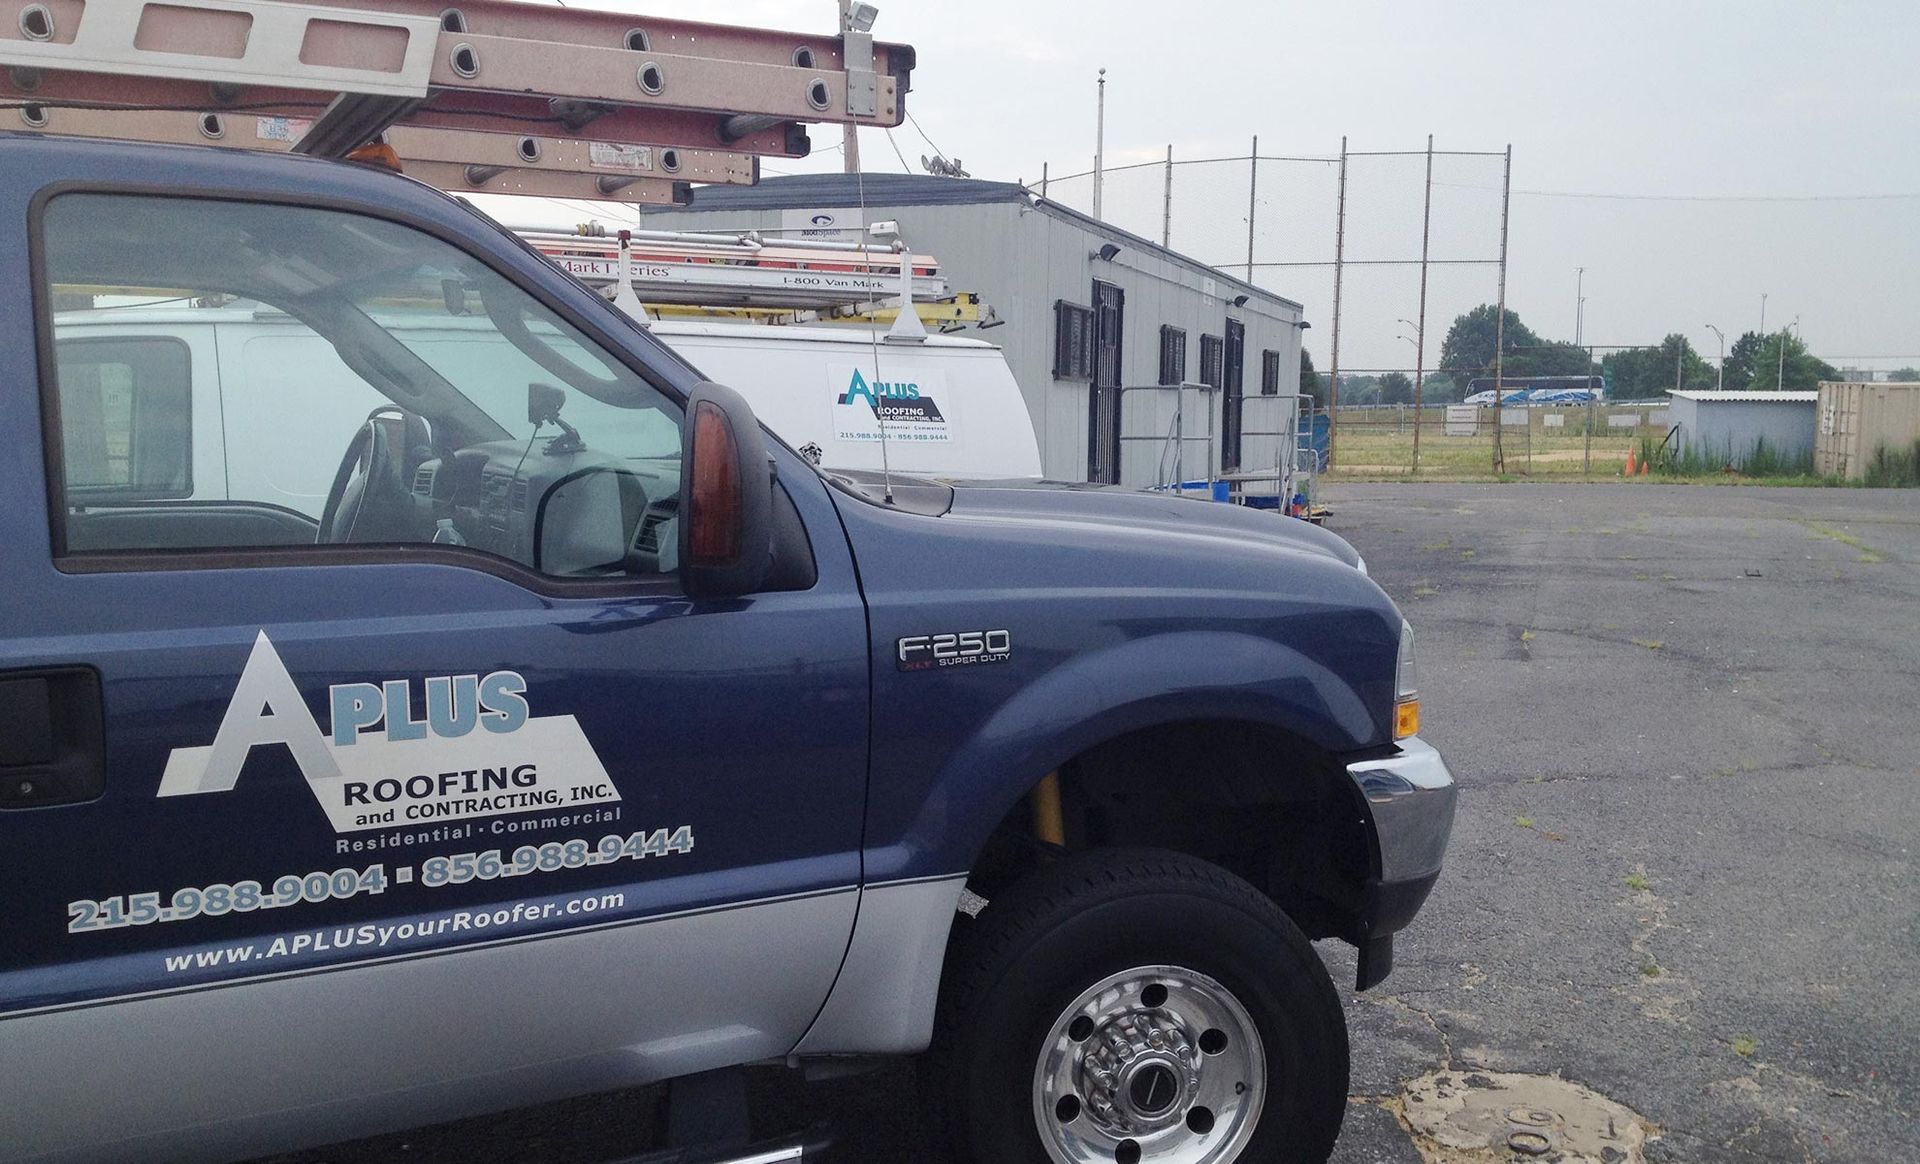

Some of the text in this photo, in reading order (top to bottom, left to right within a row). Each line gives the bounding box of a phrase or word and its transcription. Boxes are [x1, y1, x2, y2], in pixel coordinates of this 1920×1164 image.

[618, 264, 669, 278] eries
[825, 279, 849, 287] Van
[852, 280, 884, 288] Mark
[877, 406, 924, 416] ROOFING
[939, 655, 977, 666] SUPER
[980, 653, 1010, 662] DUTY
[343, 764, 537, 806] ROOFING
[355, 784, 613, 826] and CONTRACTING, INC.
[336, 807, 621, 854] Residential Commercial
[68, 825, 694, 933] 215.988.9004 856.988.9444
[165, 892, 625, 972] www.APLUSyourRoofer.com
